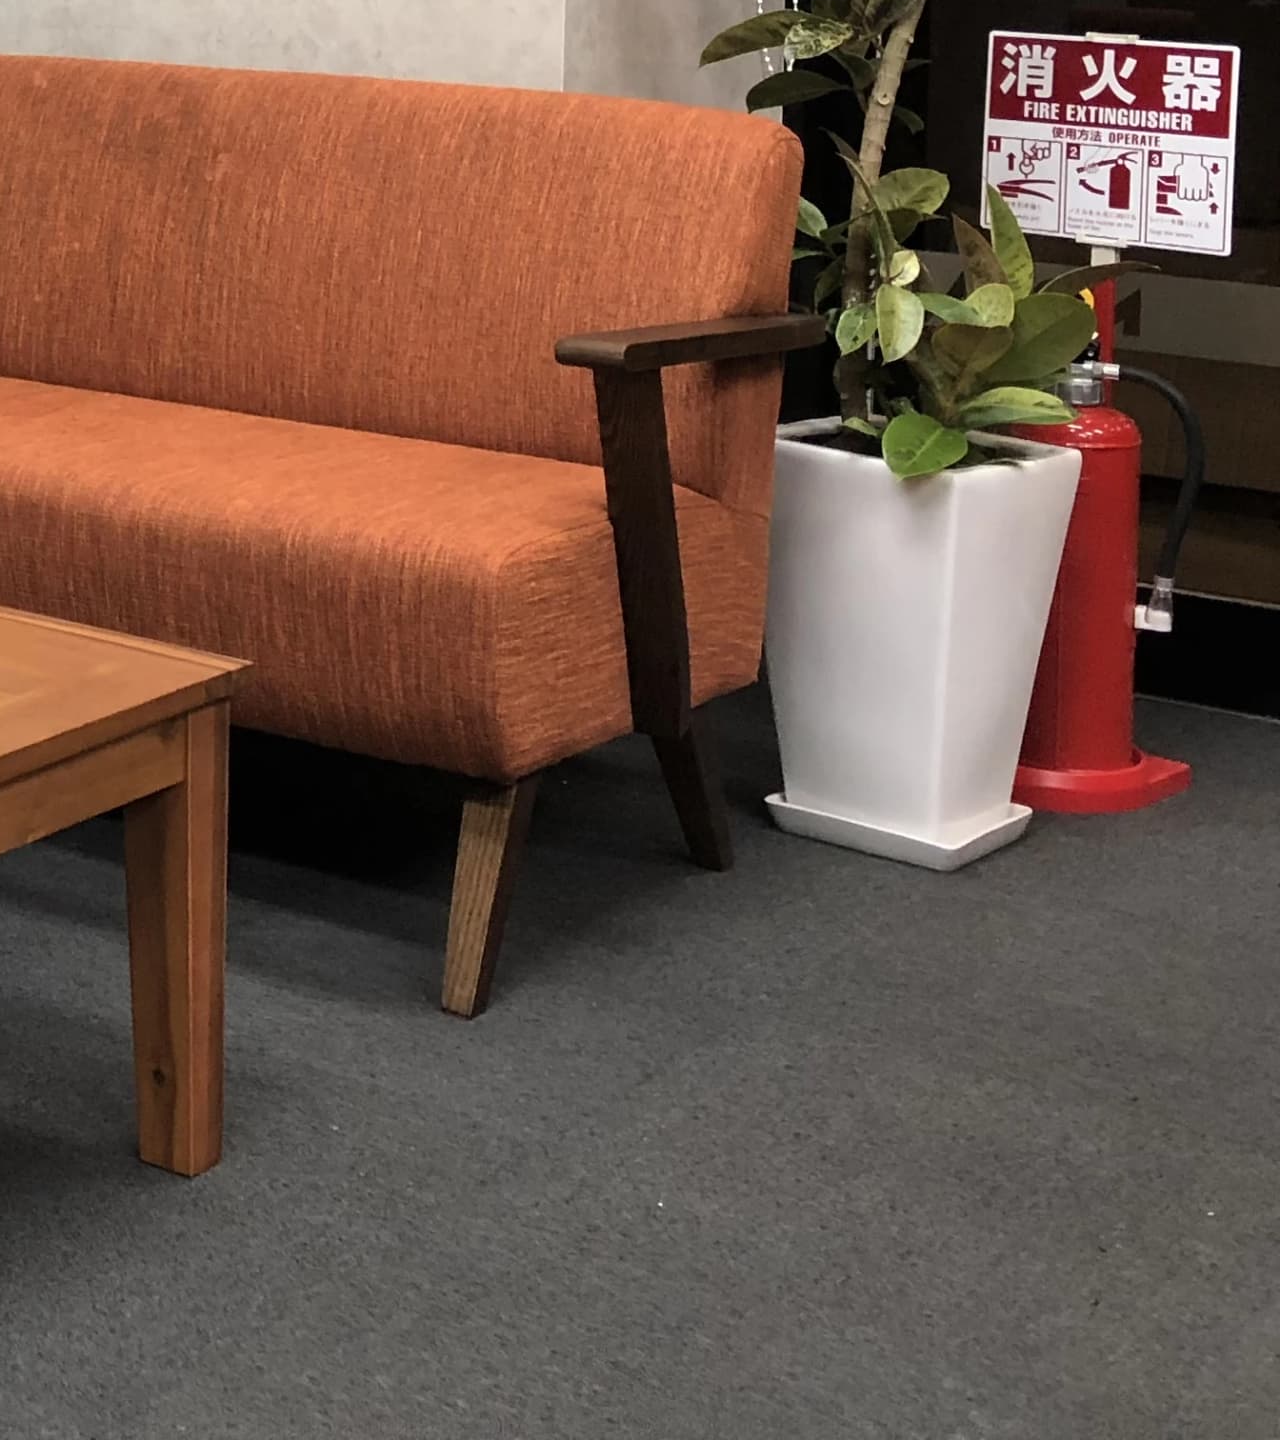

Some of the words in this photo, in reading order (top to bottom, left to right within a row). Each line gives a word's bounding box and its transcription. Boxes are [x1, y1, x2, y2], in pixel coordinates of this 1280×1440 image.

[999, 42, 1222, 112] 消火器
[1023, 100, 1060, 120] FIRE
[1066, 104, 1192, 132] EXTINGUISHER
[1051, 126, 1102, 142] 使用方法
[1108, 132, 1161, 147] OPERATE
[1069, 146, 1078, 158] 2
[1151, 153, 1160, 165] 3
